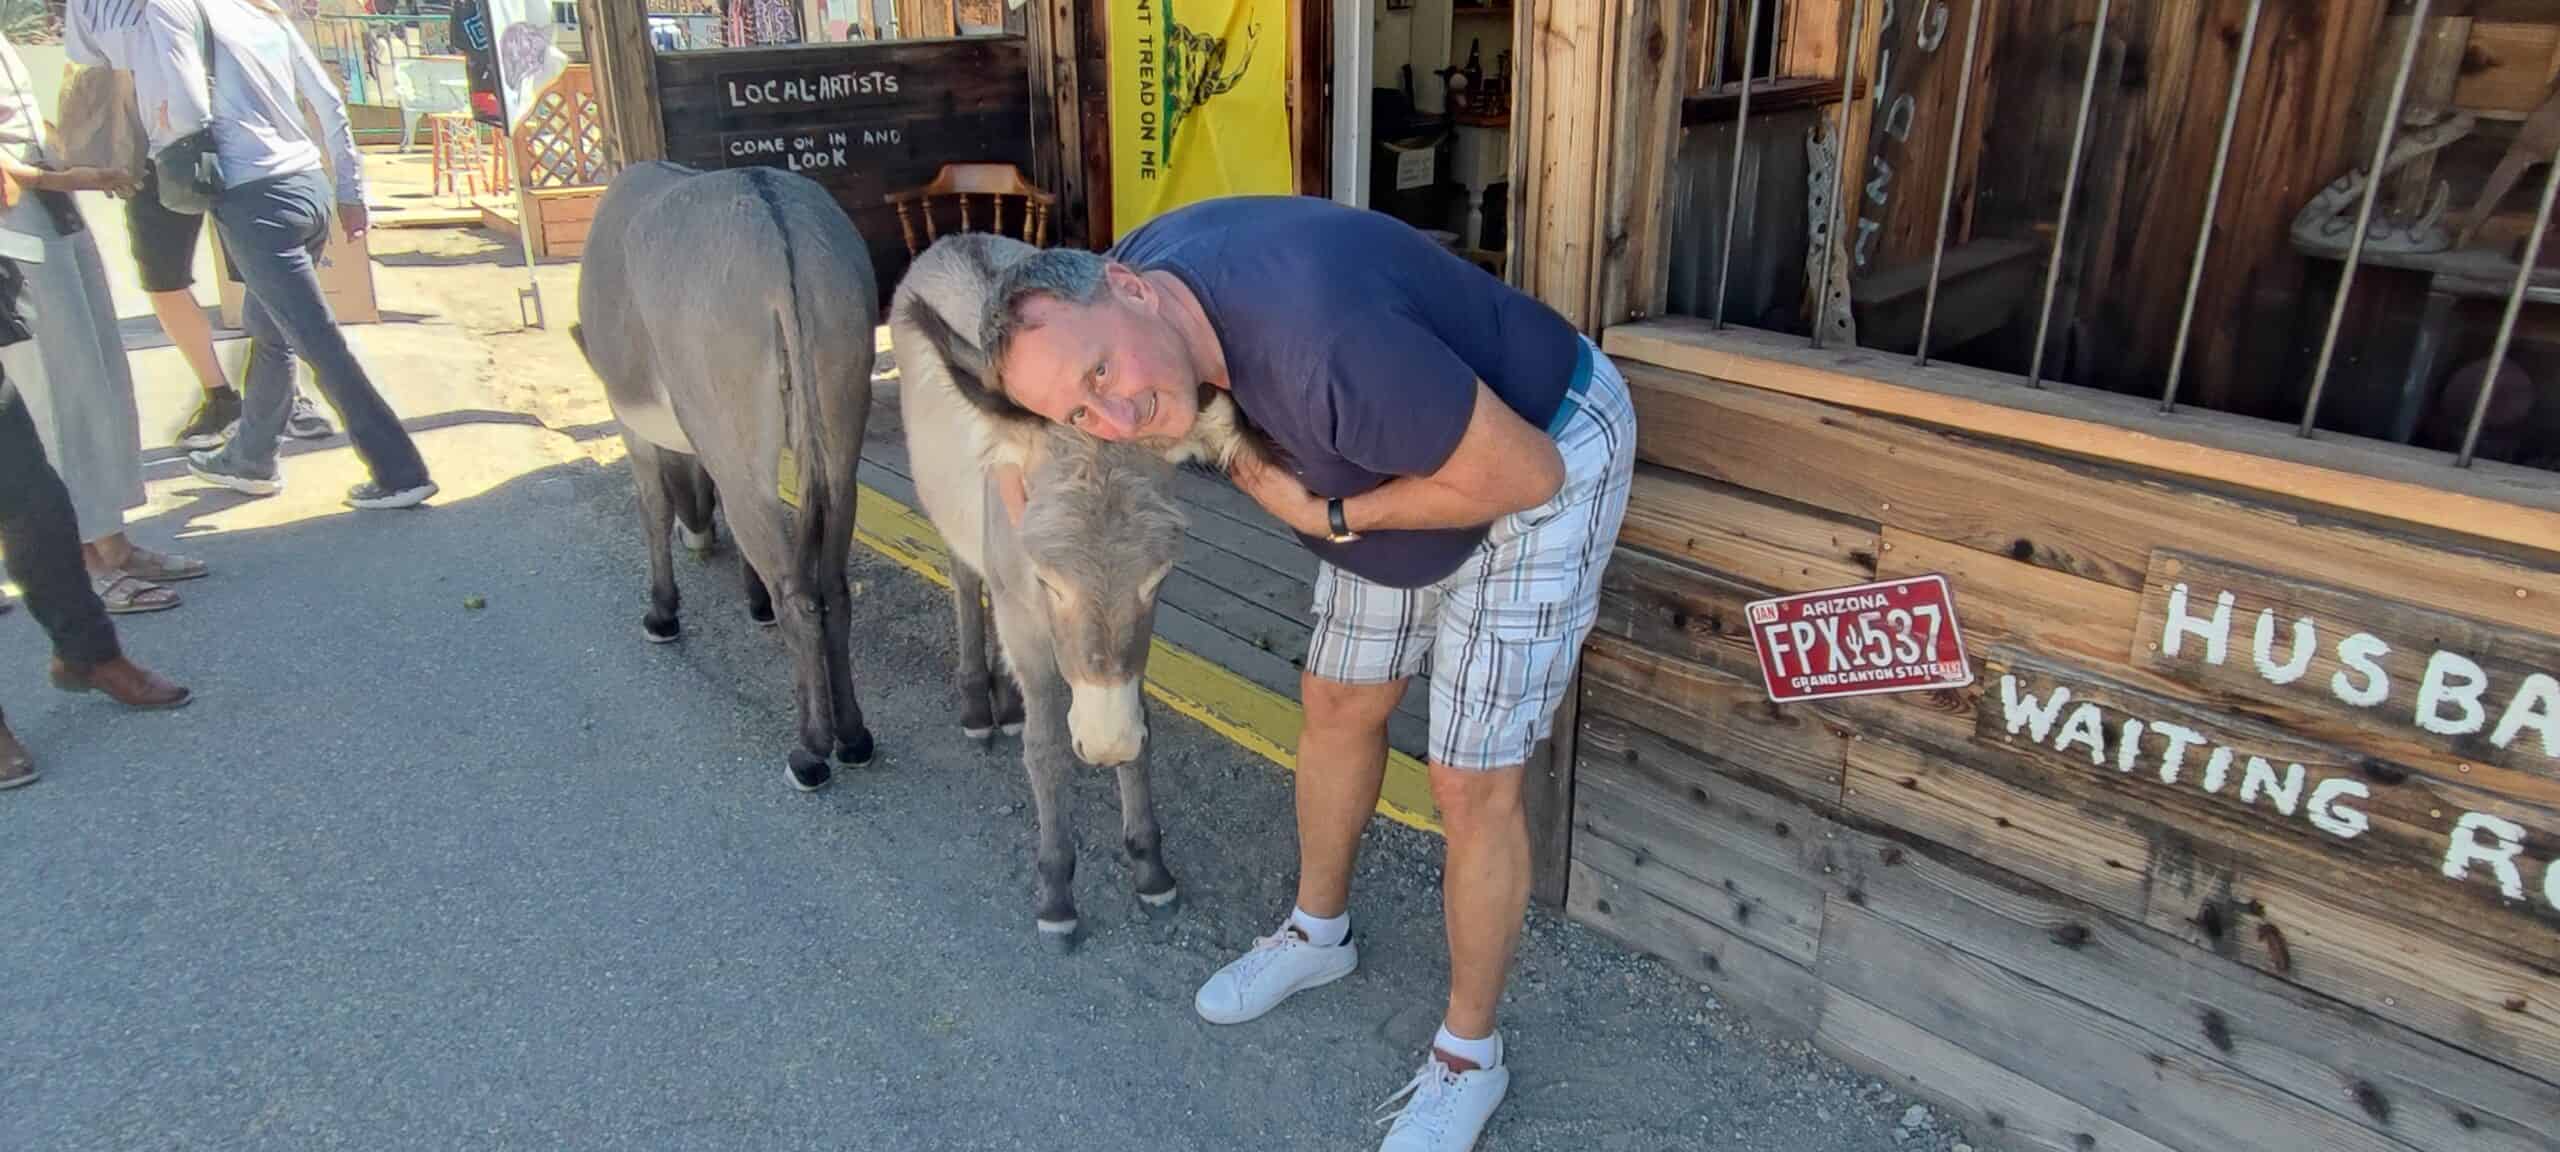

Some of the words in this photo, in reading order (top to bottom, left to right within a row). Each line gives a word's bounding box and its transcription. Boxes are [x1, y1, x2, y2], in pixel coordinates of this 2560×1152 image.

[1138, 35, 1155, 106] TREAD
[1140, 112, 1156, 141] ON
[730, 137, 785, 156] COME
[793, 137, 814, 150] ON
[828, 132, 847, 146] IN
[863, 130, 901, 145] AND
[788, 148, 847, 171] LOOK
[1140, 151, 1156, 180] ME
[1755, 607, 1776, 620] JAN
[1802, 593, 1889, 617] ARIZONA
[1791, 674, 1837, 688] GRAND
[1840, 667, 1895, 684] CANYON
[1896, 662, 1939, 679] STATE
[2162, 583, 2560, 758] HUSBA
[2000, 674, 2370, 840] WAITING
